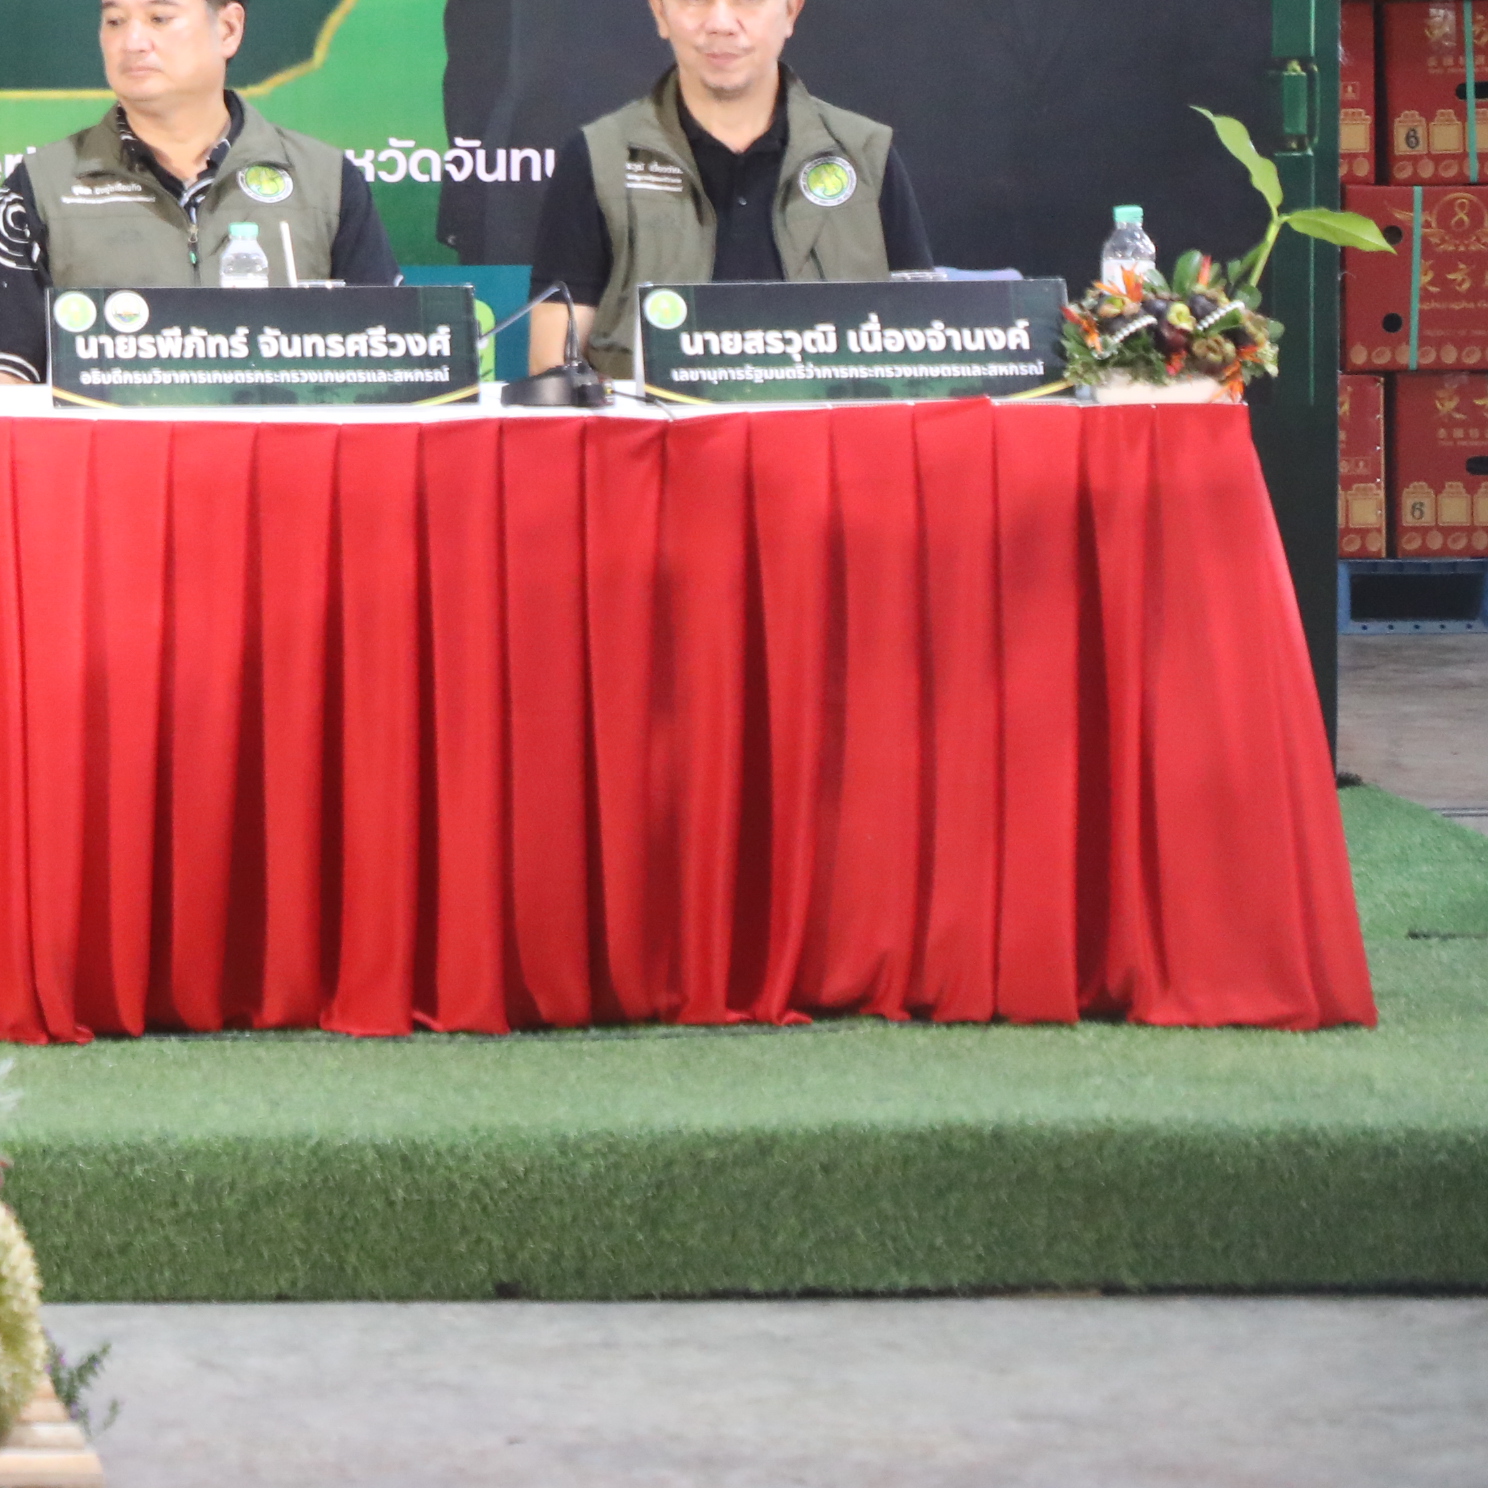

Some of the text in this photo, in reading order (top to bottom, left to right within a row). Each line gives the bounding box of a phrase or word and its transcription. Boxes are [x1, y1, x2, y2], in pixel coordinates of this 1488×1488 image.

[1404, 127, 1420, 150] 6
[1449, 198, 1470, 231] 8
[256, 324, 452, 360] จันทรศรีวงศ์
[680, 312, 1031, 364] นายสรวุฒิ เนื่องจำนงค์
[1410, 500, 1426, 521] 6
